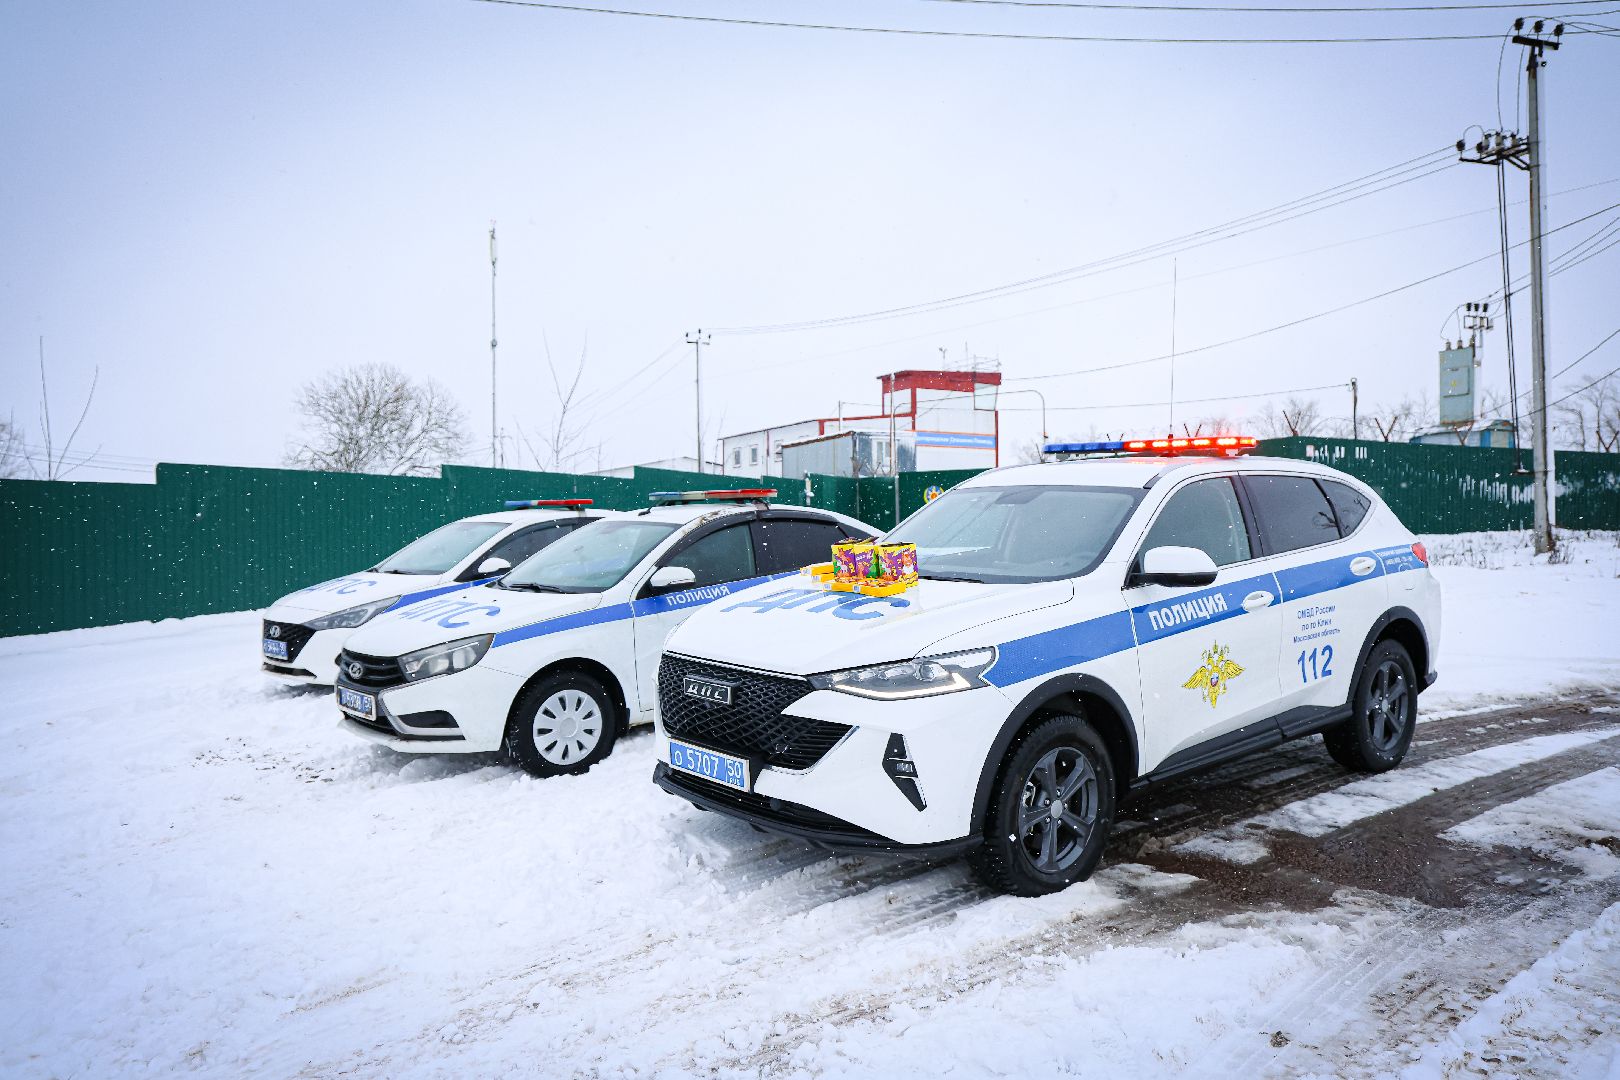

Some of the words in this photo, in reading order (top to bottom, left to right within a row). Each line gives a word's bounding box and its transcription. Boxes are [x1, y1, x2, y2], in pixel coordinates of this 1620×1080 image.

[666, 585, 730, 606] ПОЛИЦИЯ
[720, 587, 910, 620] ДПС
[1315, 605, 1336, 616] России
[1148, 592, 1228, 631] ПОЛИЦИЯ
[1297, 644, 1333, 683] 112
[687, 748, 719, 777] 5707
[726, 759, 741, 778] 50
